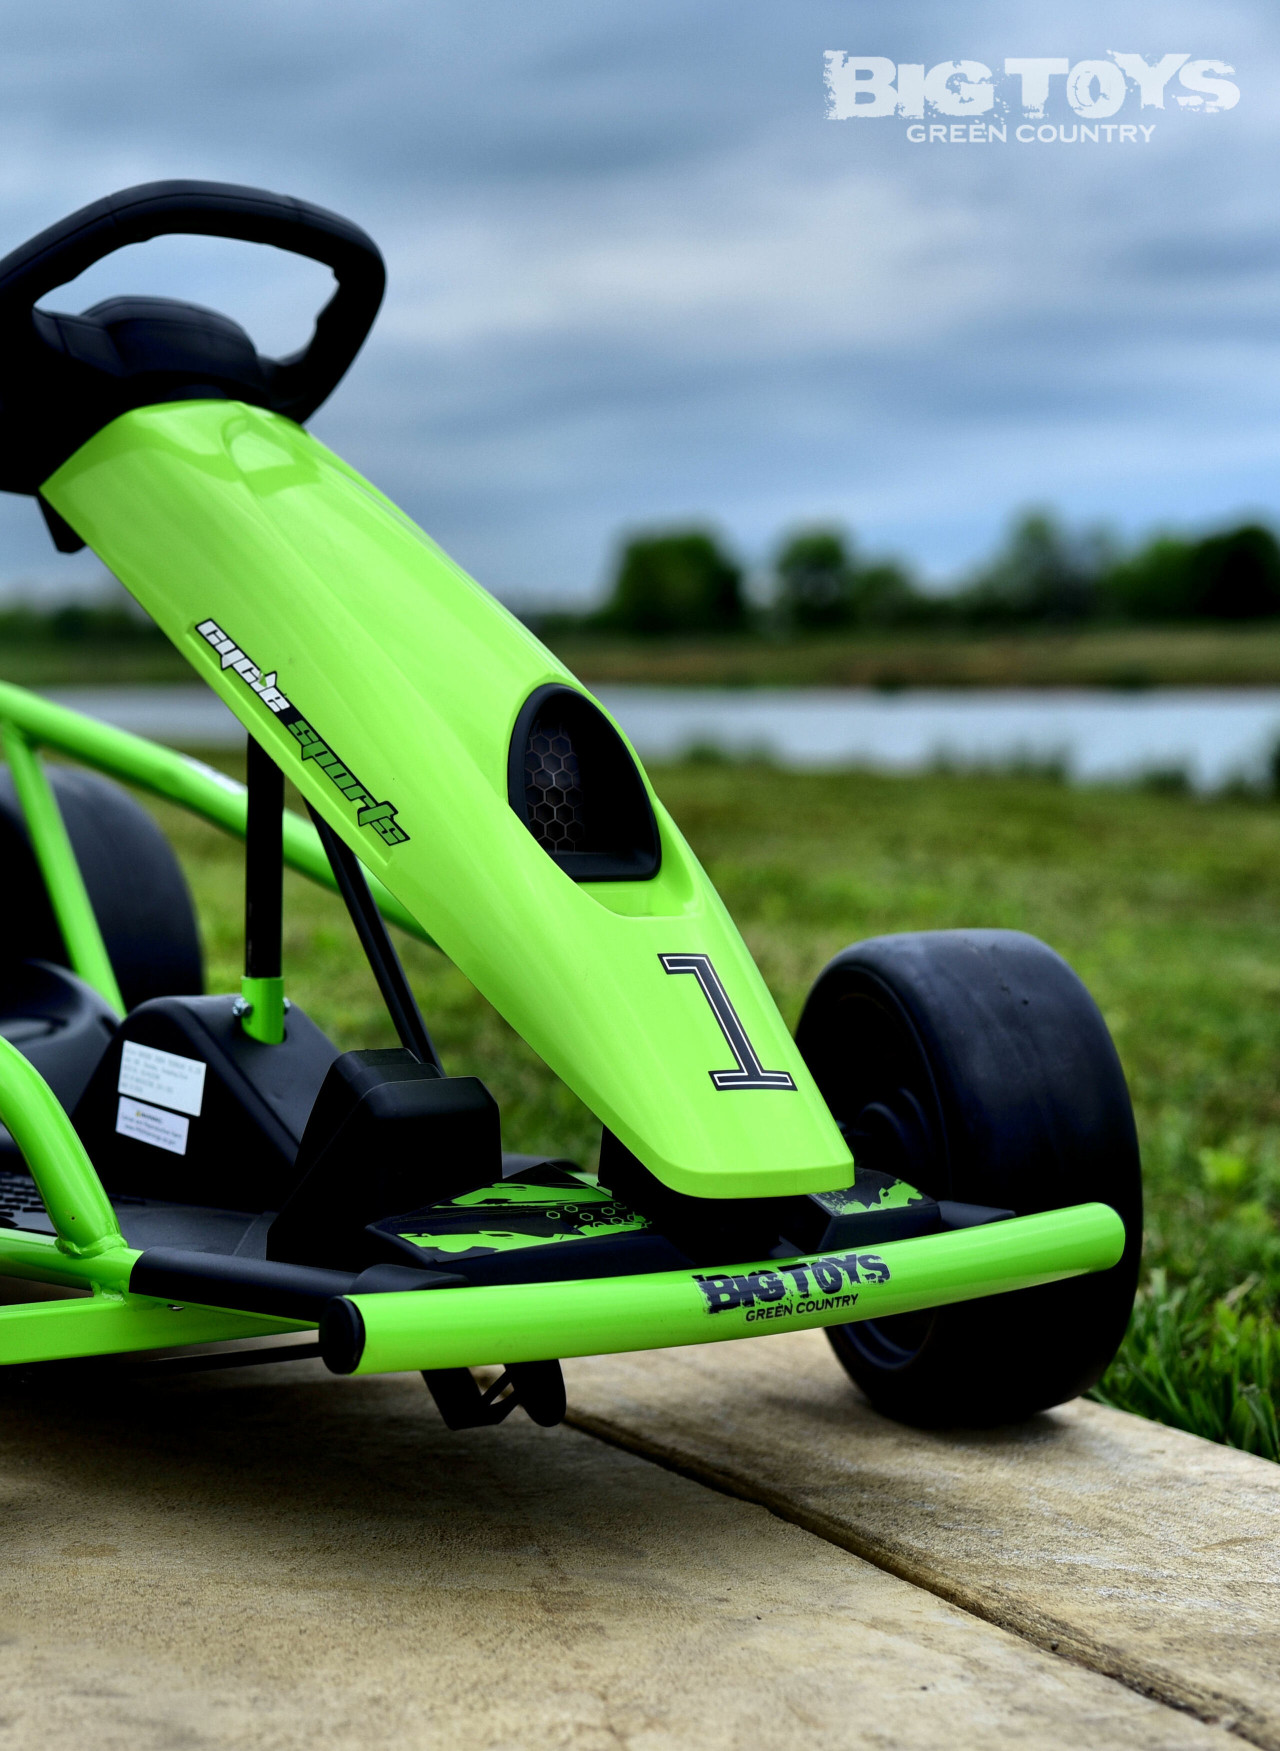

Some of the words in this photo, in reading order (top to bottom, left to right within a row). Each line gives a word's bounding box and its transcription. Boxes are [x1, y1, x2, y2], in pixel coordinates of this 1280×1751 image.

[286, 718, 411, 846] sports
[657, 953, 798, 1091] 1
[692, 1269, 787, 1315] BIG
[778, 1254, 891, 1299] TOYS
[745, 1303, 793, 1322] GREEN
[795, 1293, 859, 1315] COUNTRY
